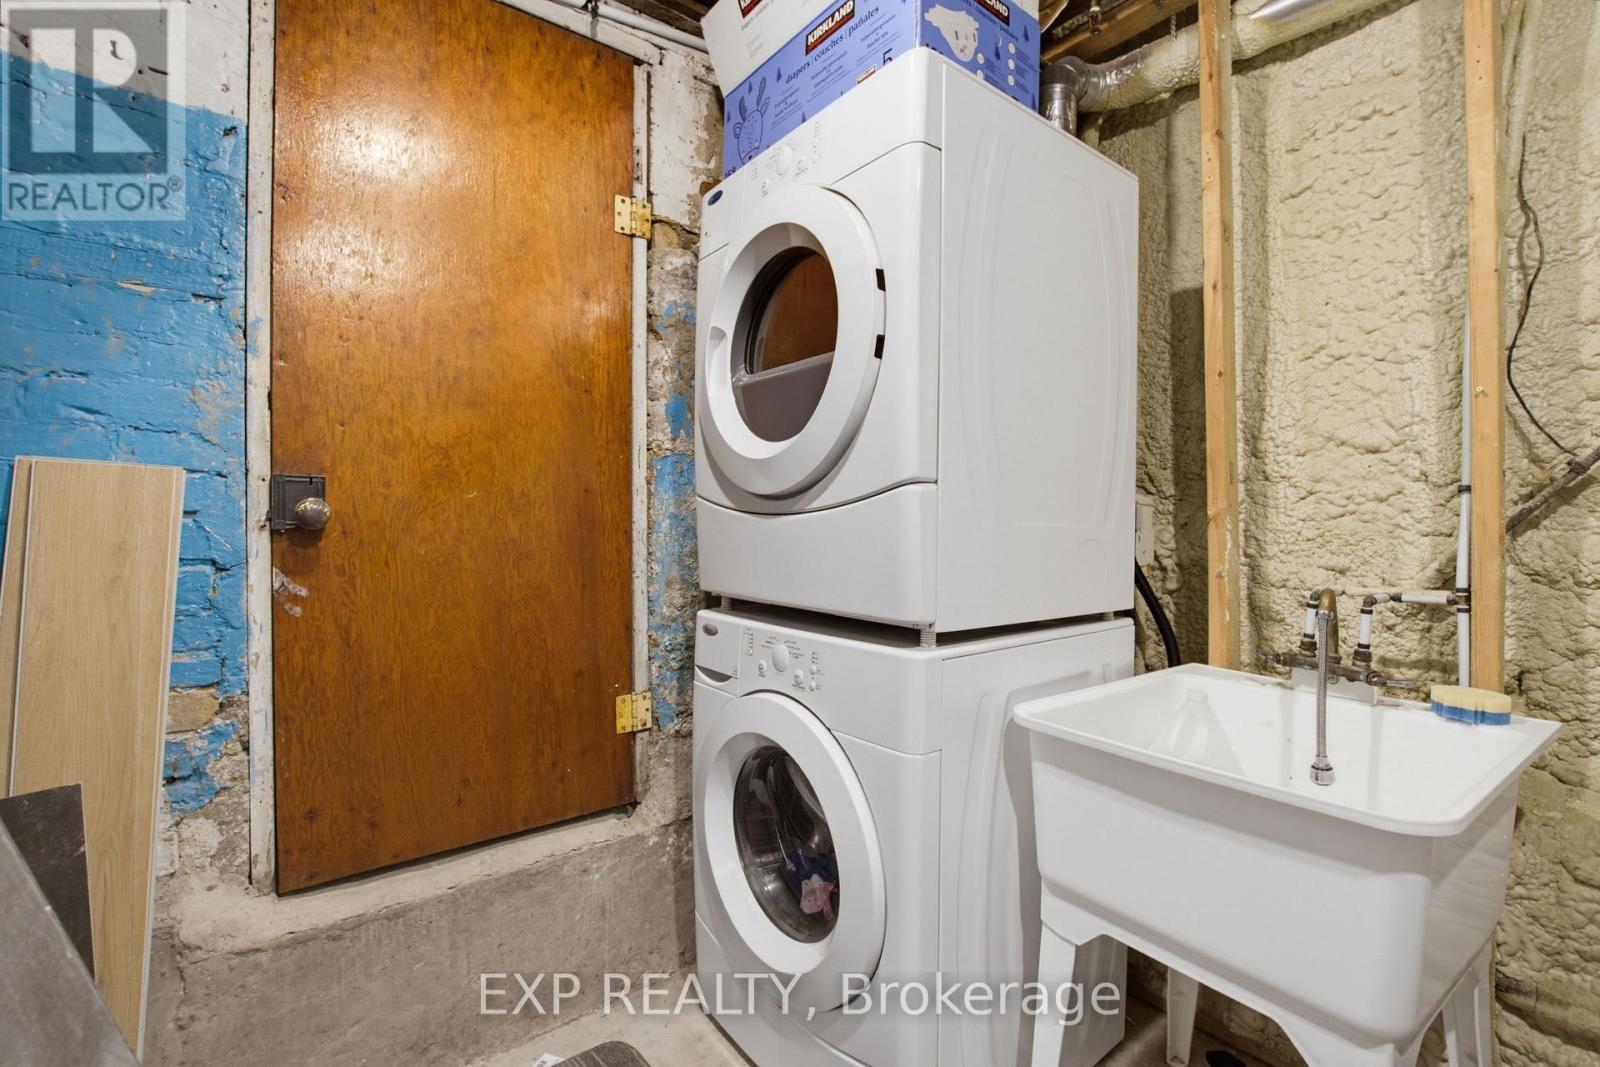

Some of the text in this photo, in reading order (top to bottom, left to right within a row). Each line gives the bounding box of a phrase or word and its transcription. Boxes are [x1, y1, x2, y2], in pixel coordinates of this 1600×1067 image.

[807, 0, 854, 46] KIRKLAND
[786, 61, 811, 84] diapers
[814, 34, 844, 62] couches
